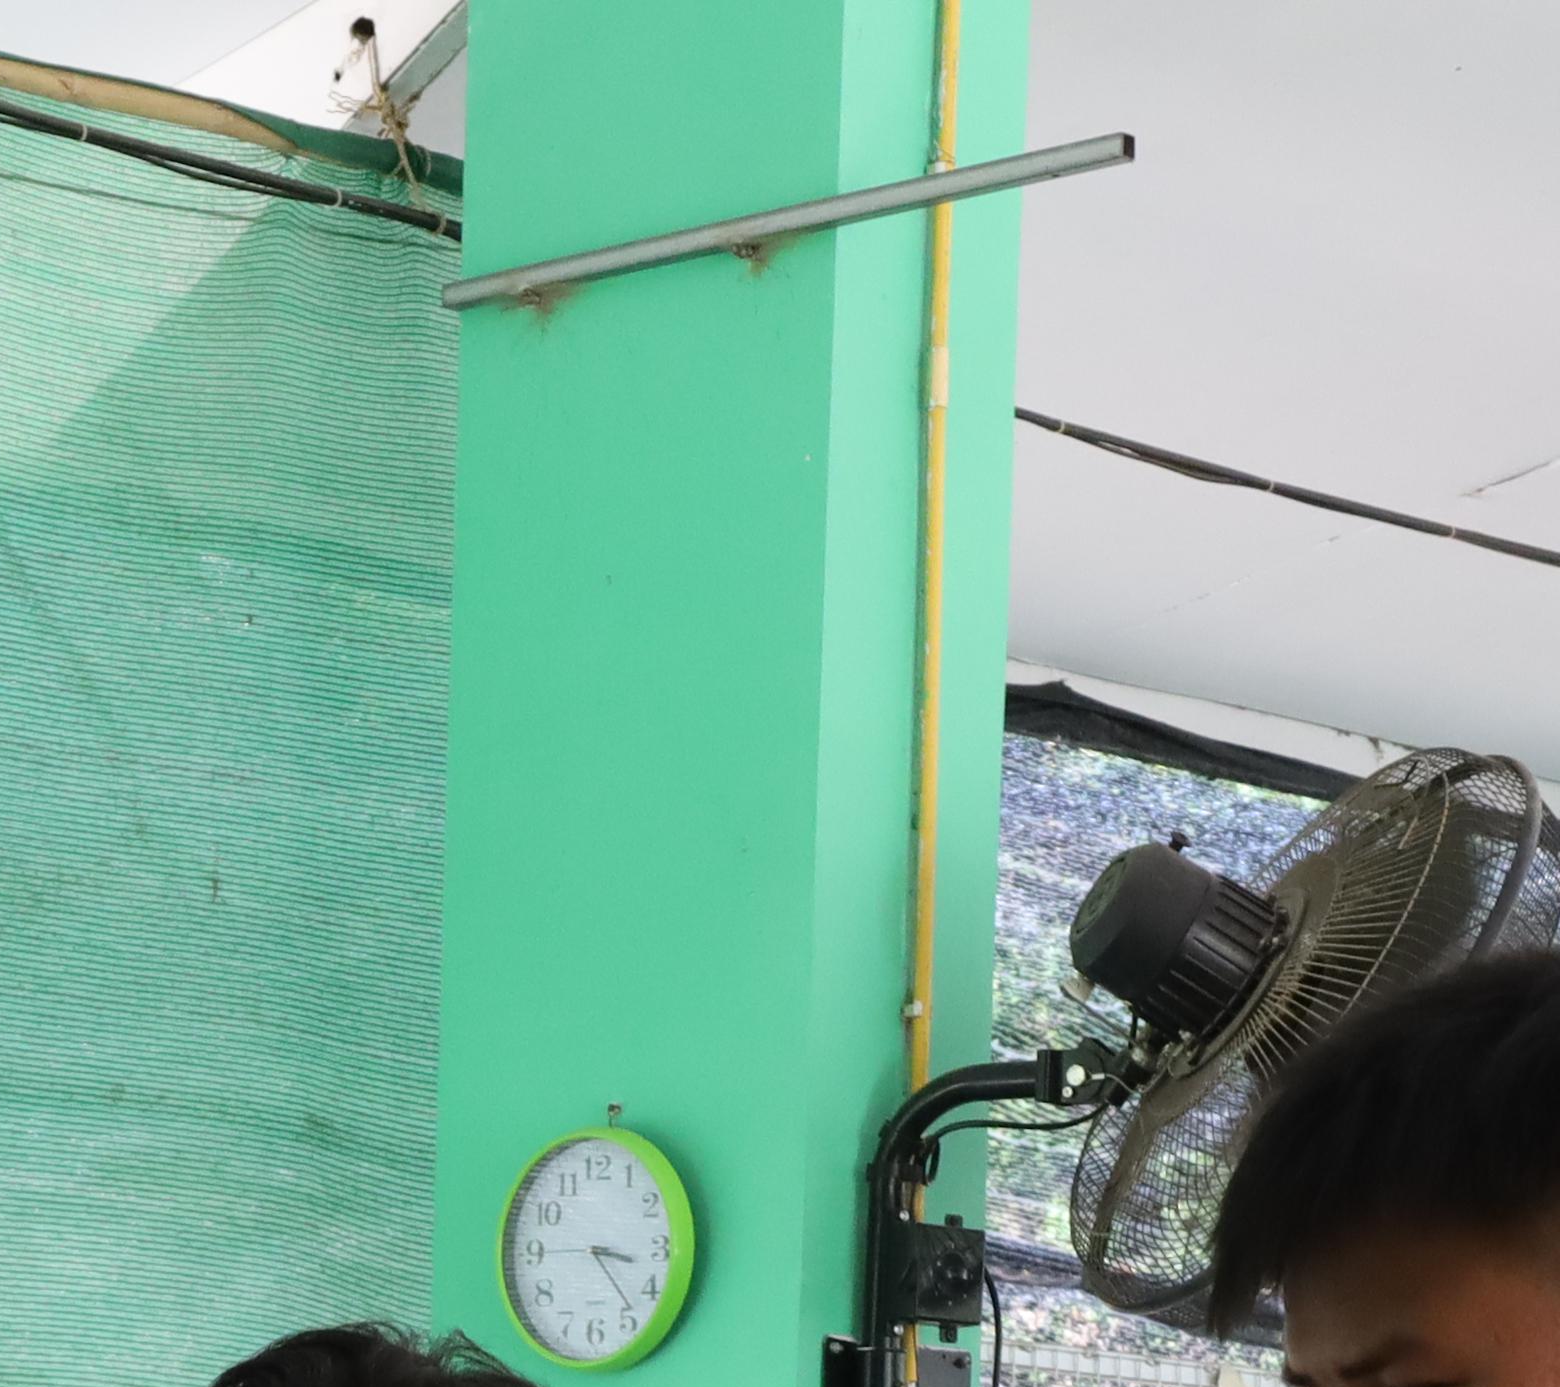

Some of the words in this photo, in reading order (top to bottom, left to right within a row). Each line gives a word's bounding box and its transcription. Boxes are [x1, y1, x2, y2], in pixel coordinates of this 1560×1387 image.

[584, 1154, 612, 1181] 12
[624, 1163, 634, 1188] 1
[558, 1173, 579, 1197] 11
[536, 1201, 562, 1226] 10
[642, 1192, 659, 1218] 2
[526, 1239, 545, 1266] 9
[651, 1235, 670, 1262] 3
[534, 1279, 554, 1307] 8
[641, 1274, 660, 1301] 4
[557, 1311, 574, 1338] 7
[586, 1318, 606, 1345] 6
[619, 1307, 638, 1332] 5
